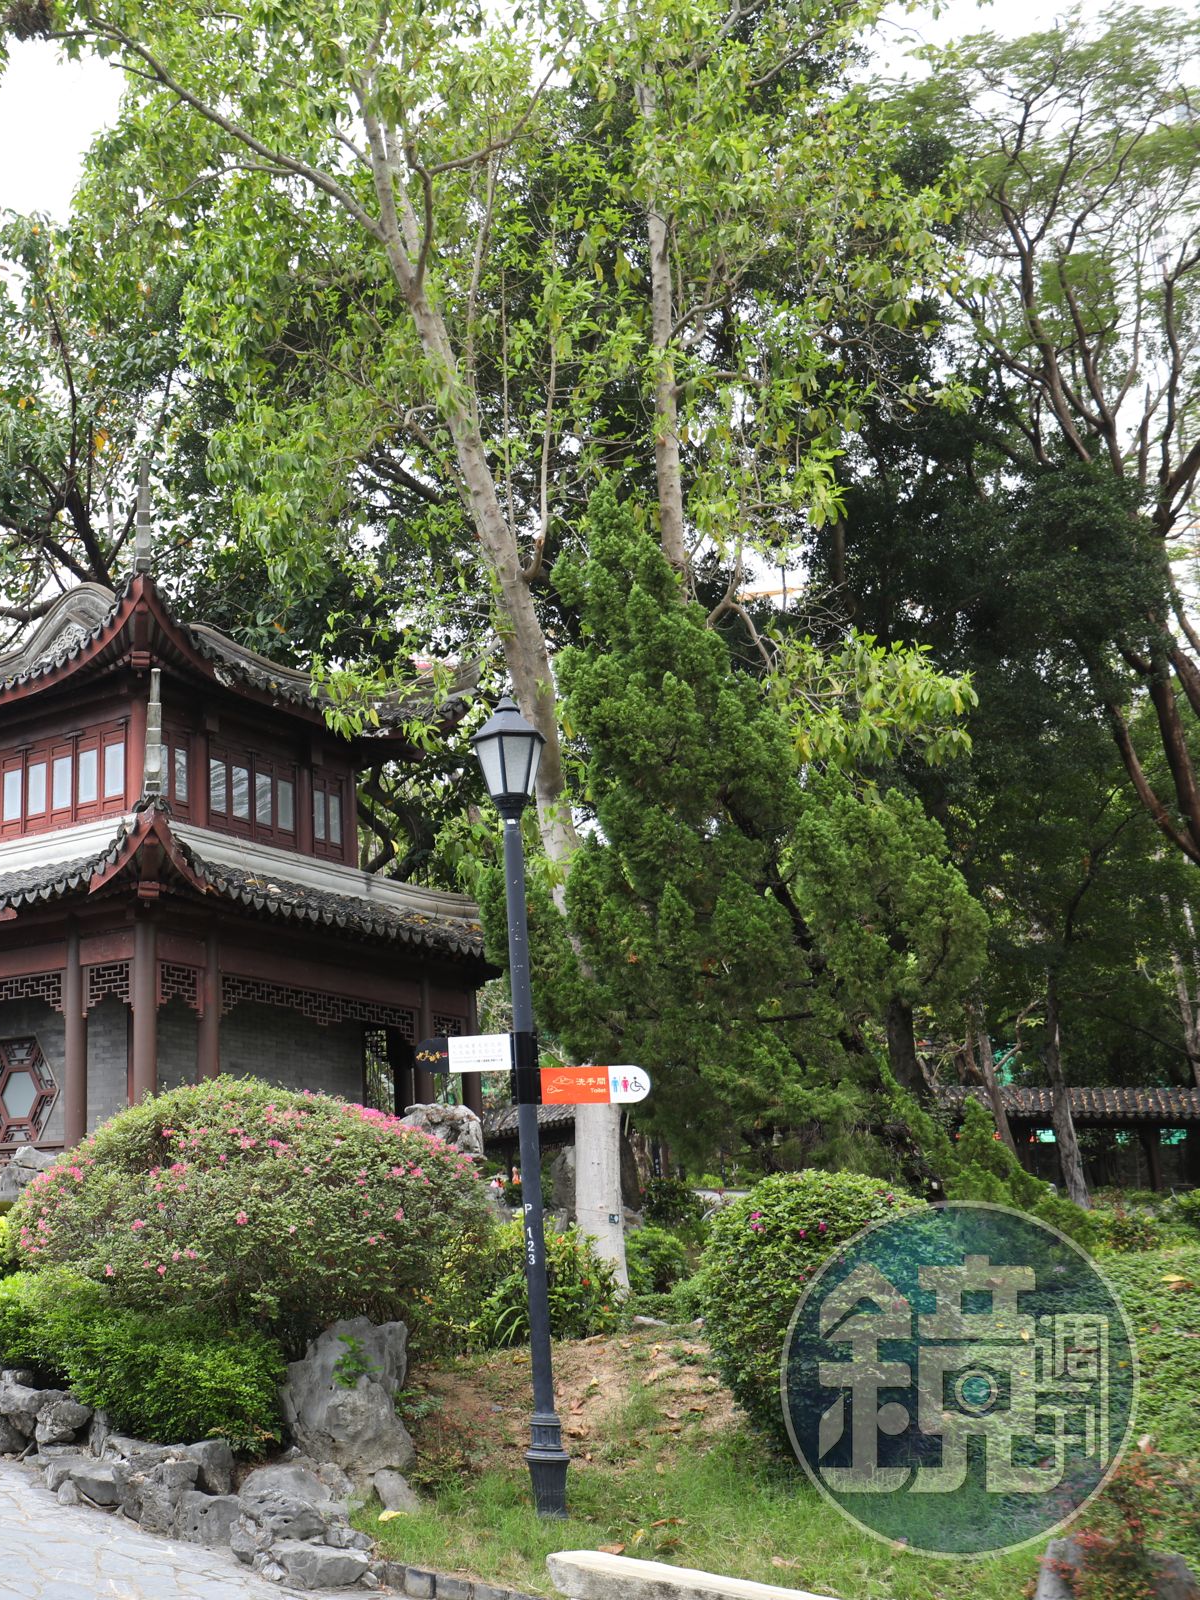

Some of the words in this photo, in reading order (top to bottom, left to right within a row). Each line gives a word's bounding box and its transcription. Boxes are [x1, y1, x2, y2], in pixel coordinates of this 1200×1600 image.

[575, 1077, 606, 1086] 洗手間
[524, 1203, 533, 1215] P
[526, 1226, 536, 1265] 123
